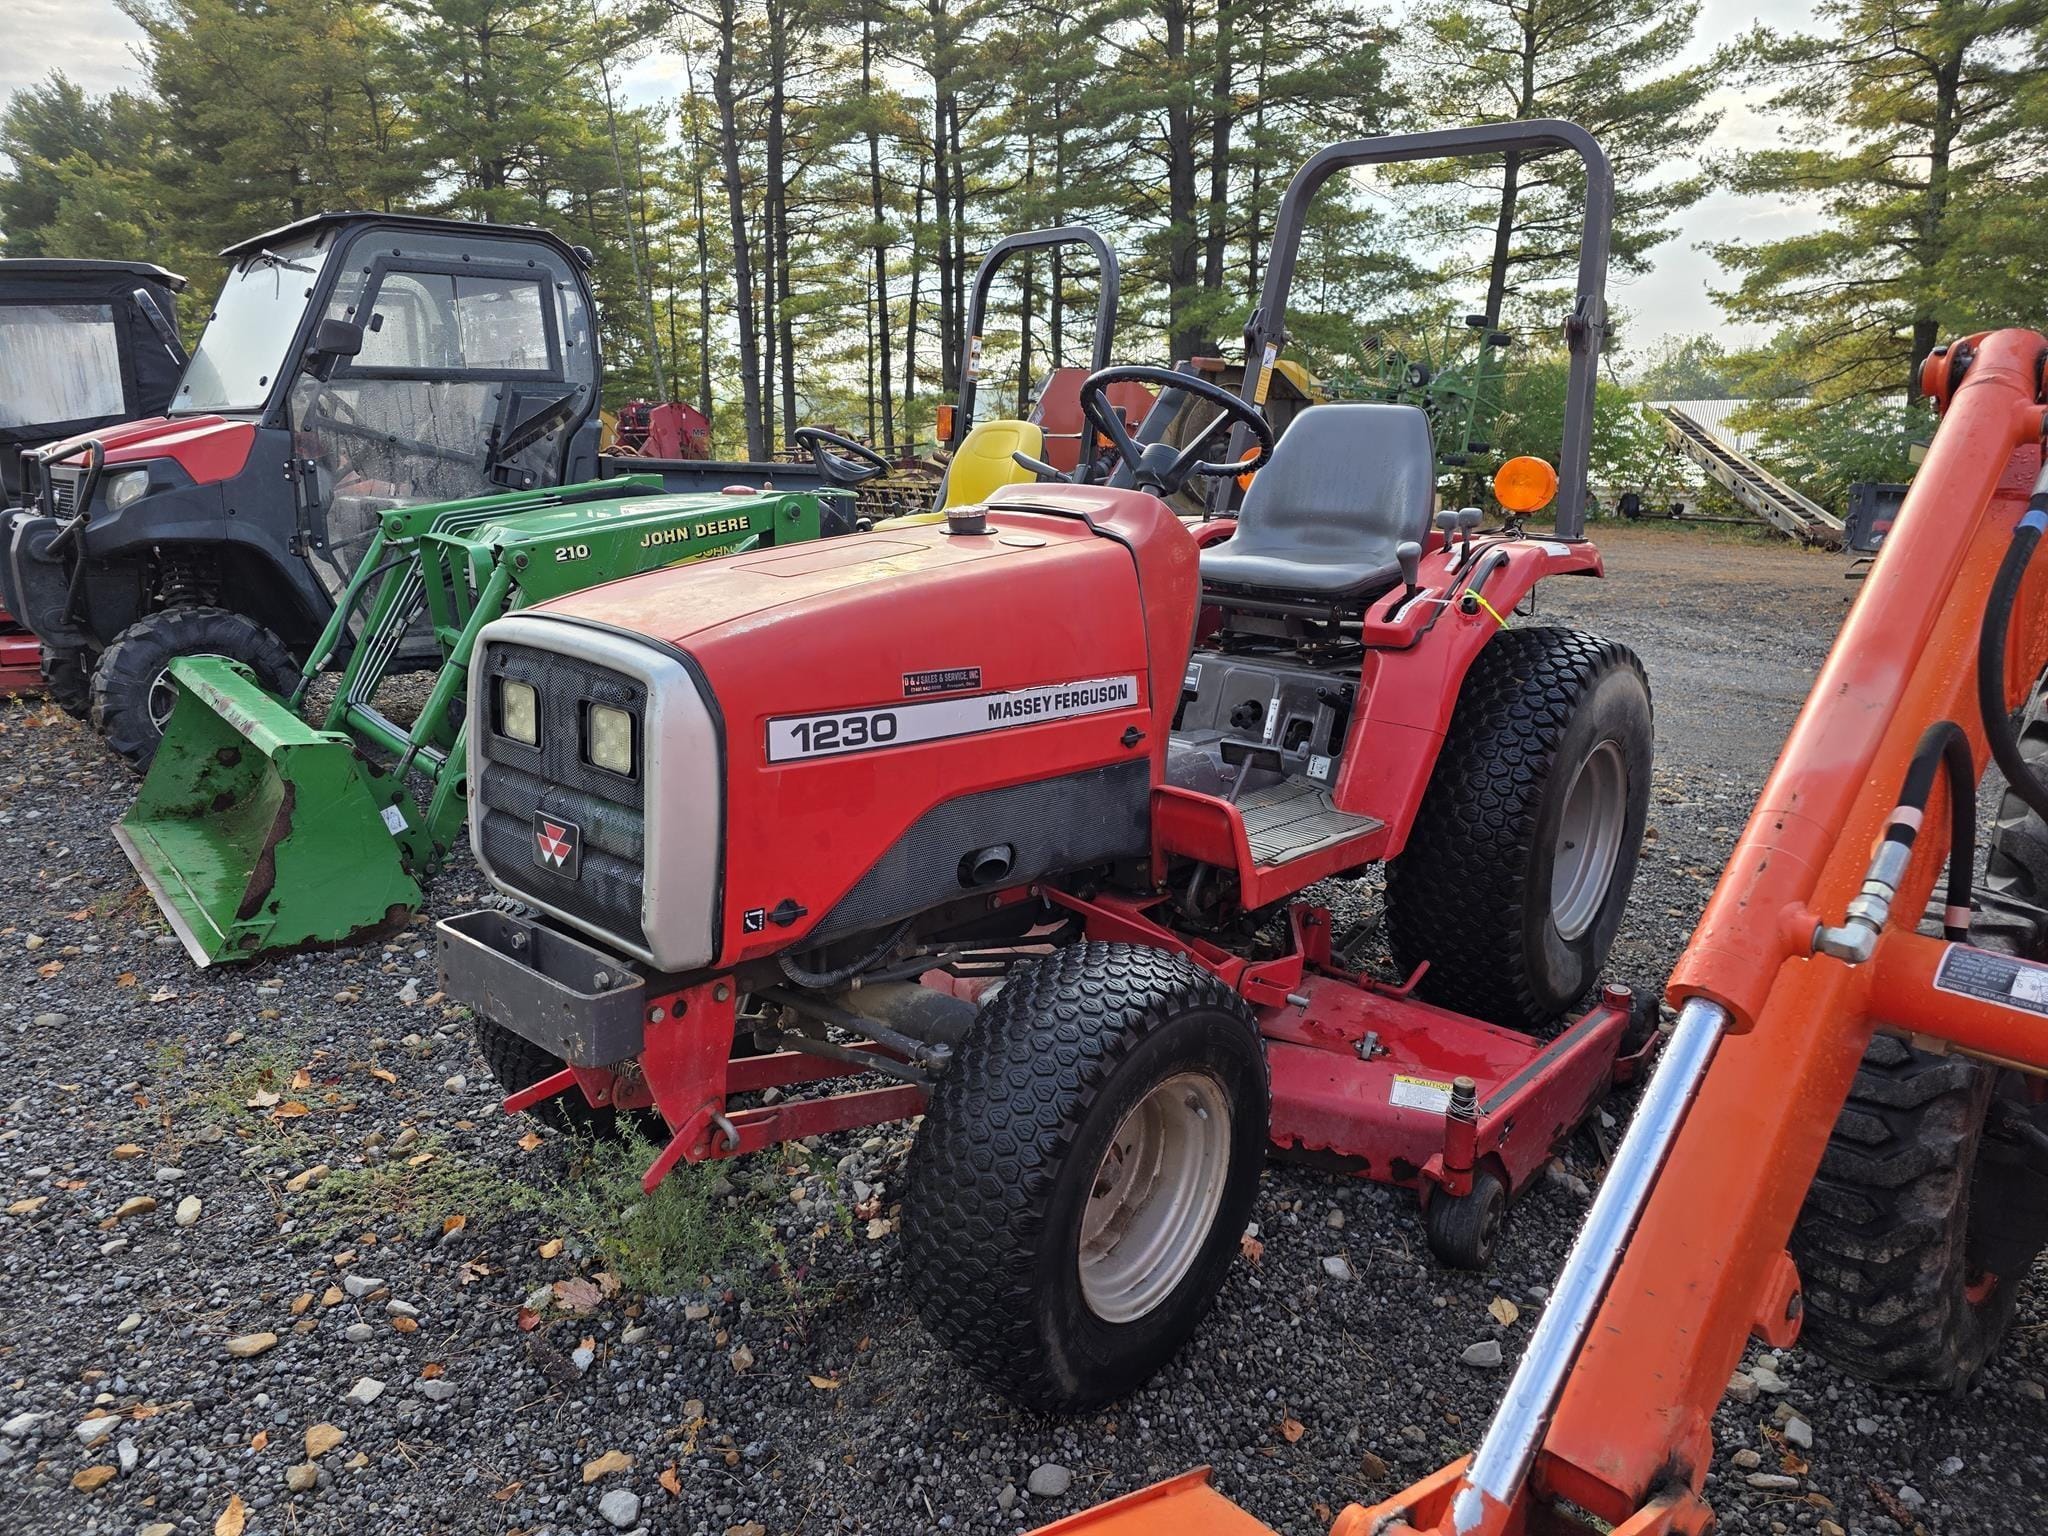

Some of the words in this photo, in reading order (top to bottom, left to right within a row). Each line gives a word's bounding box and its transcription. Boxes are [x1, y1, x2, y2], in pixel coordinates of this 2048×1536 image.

[640, 527, 690, 548] JOHN
[695, 516, 750, 538] DEERE
[555, 544, 591, 562] 210
[910, 676, 916, 686] &
[920, 674, 938, 684] SALES
[939, 673, 944, 682] &
[988, 695, 1052, 722] MASSEY
[1054, 684, 1128, 711] FERGUSON
[789, 712, 898, 752] 1230
[1414, 1079, 1451, 1090] CAUTION
